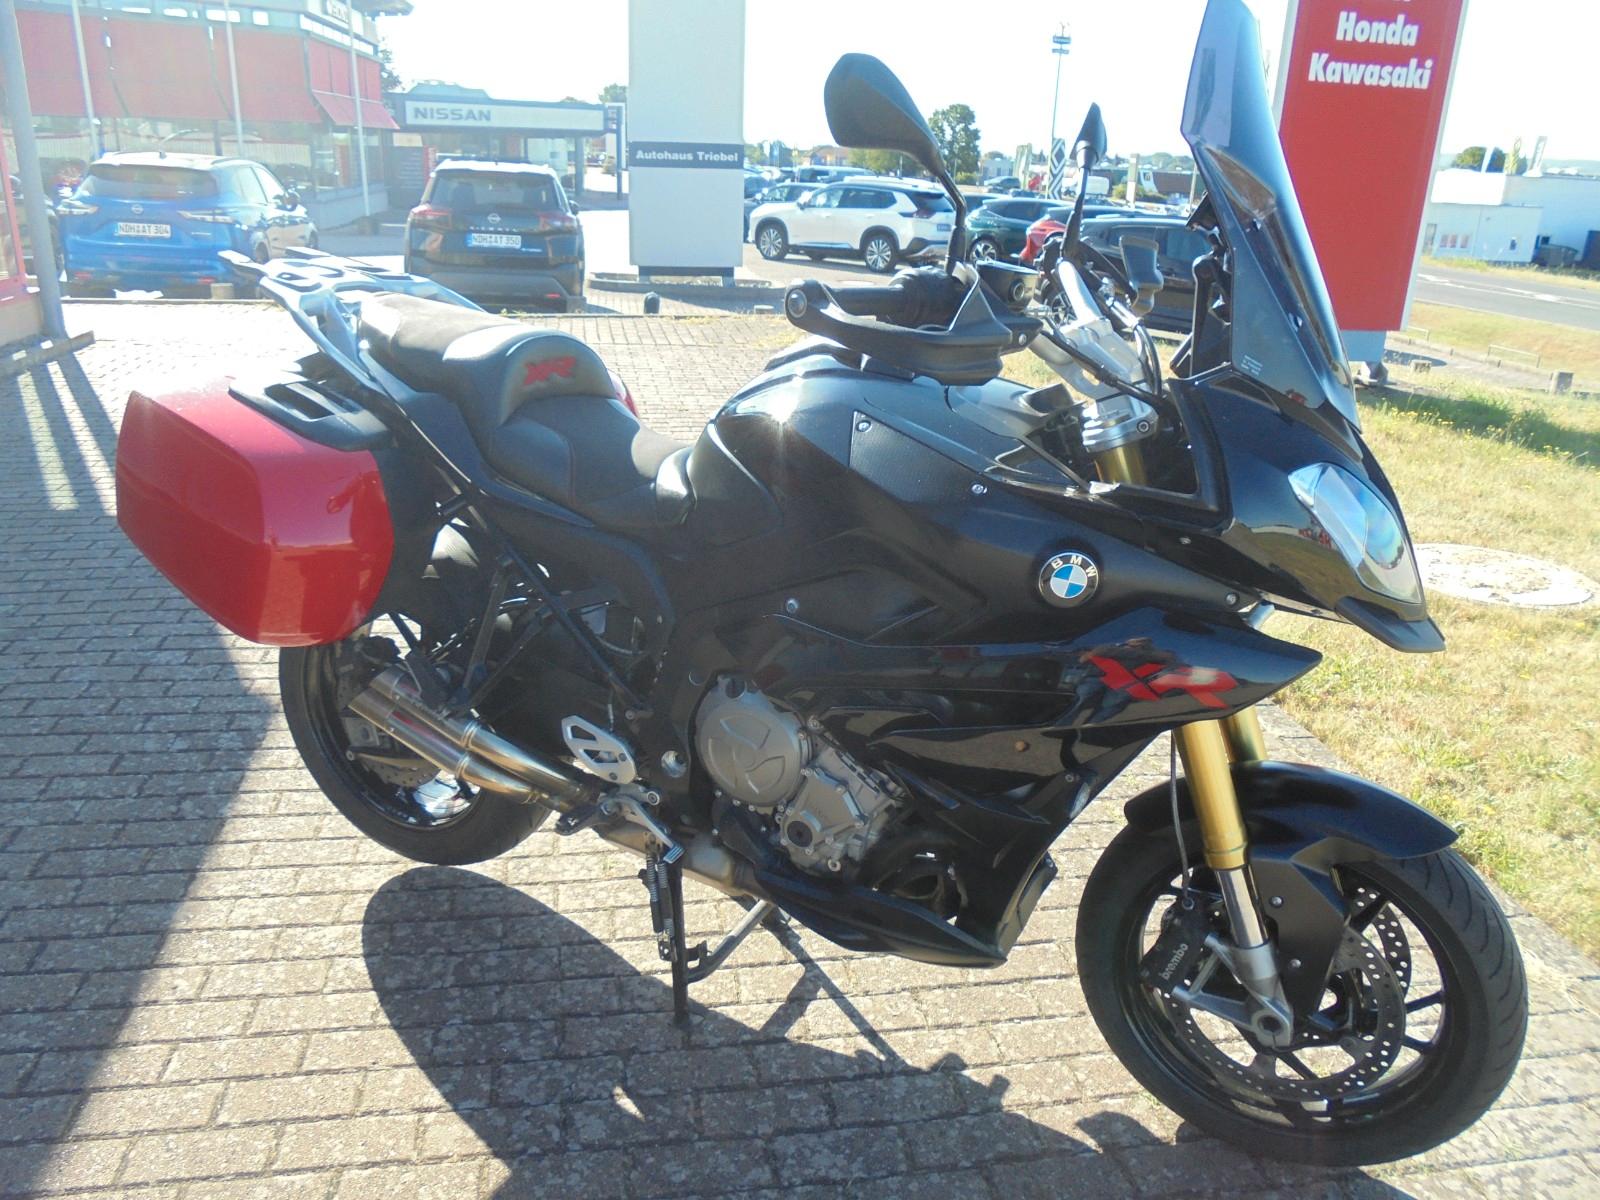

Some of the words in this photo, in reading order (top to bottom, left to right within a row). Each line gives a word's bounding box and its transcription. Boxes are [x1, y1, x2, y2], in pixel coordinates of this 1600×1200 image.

[1336, 10, 1419, 47] Honda
[1308, 52, 1433, 90] Kawasaki
[413, 106, 492, 122] NISSAN
[635, 149, 694, 161] Autohaus
[696, 151, 739, 162] Triebel
[523, 356, 577, 386] XR
[1050, 554, 1098, 578] BMW
[1089, 655, 1240, 709] XR
[1158, 943, 1189, 981] brembo
